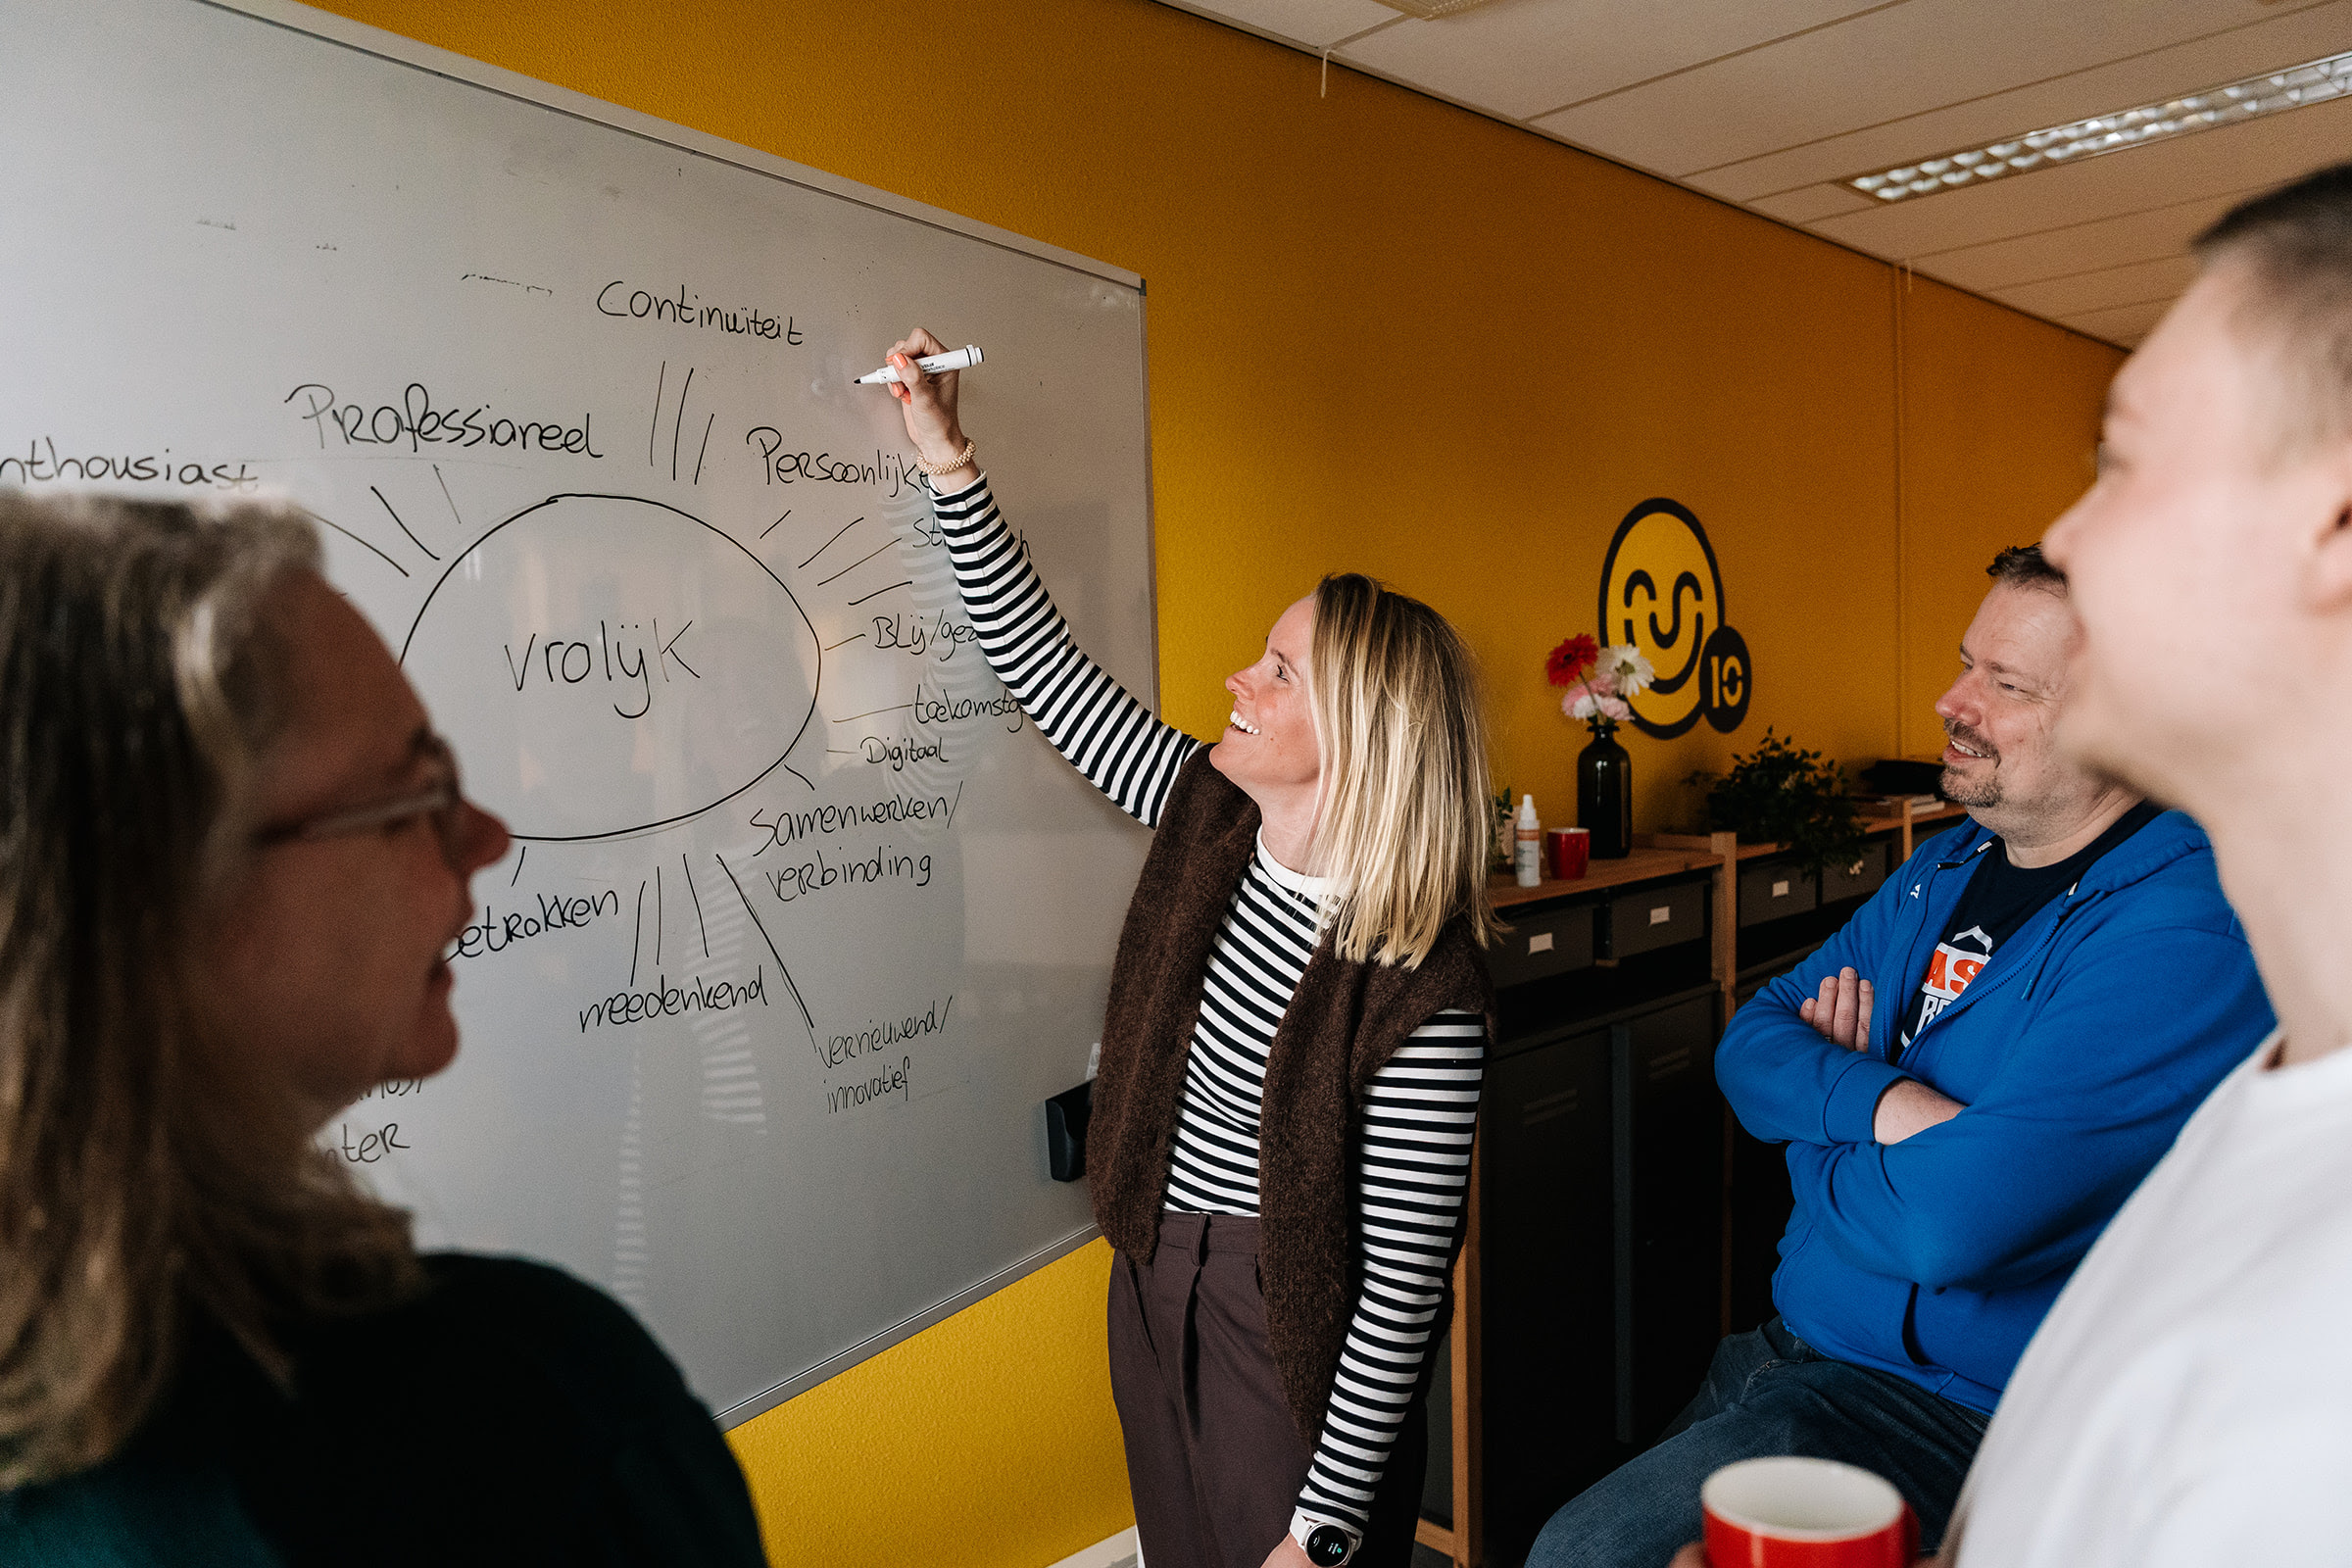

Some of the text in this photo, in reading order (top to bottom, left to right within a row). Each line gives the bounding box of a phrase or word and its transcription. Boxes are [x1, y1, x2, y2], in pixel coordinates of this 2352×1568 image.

[859, 736, 950, 772] Digitaal
[446, 889, 619, 958] etrokken
[579, 963, 769, 1034] meedenkend
[823, 1054, 910, 1114] innovatief
